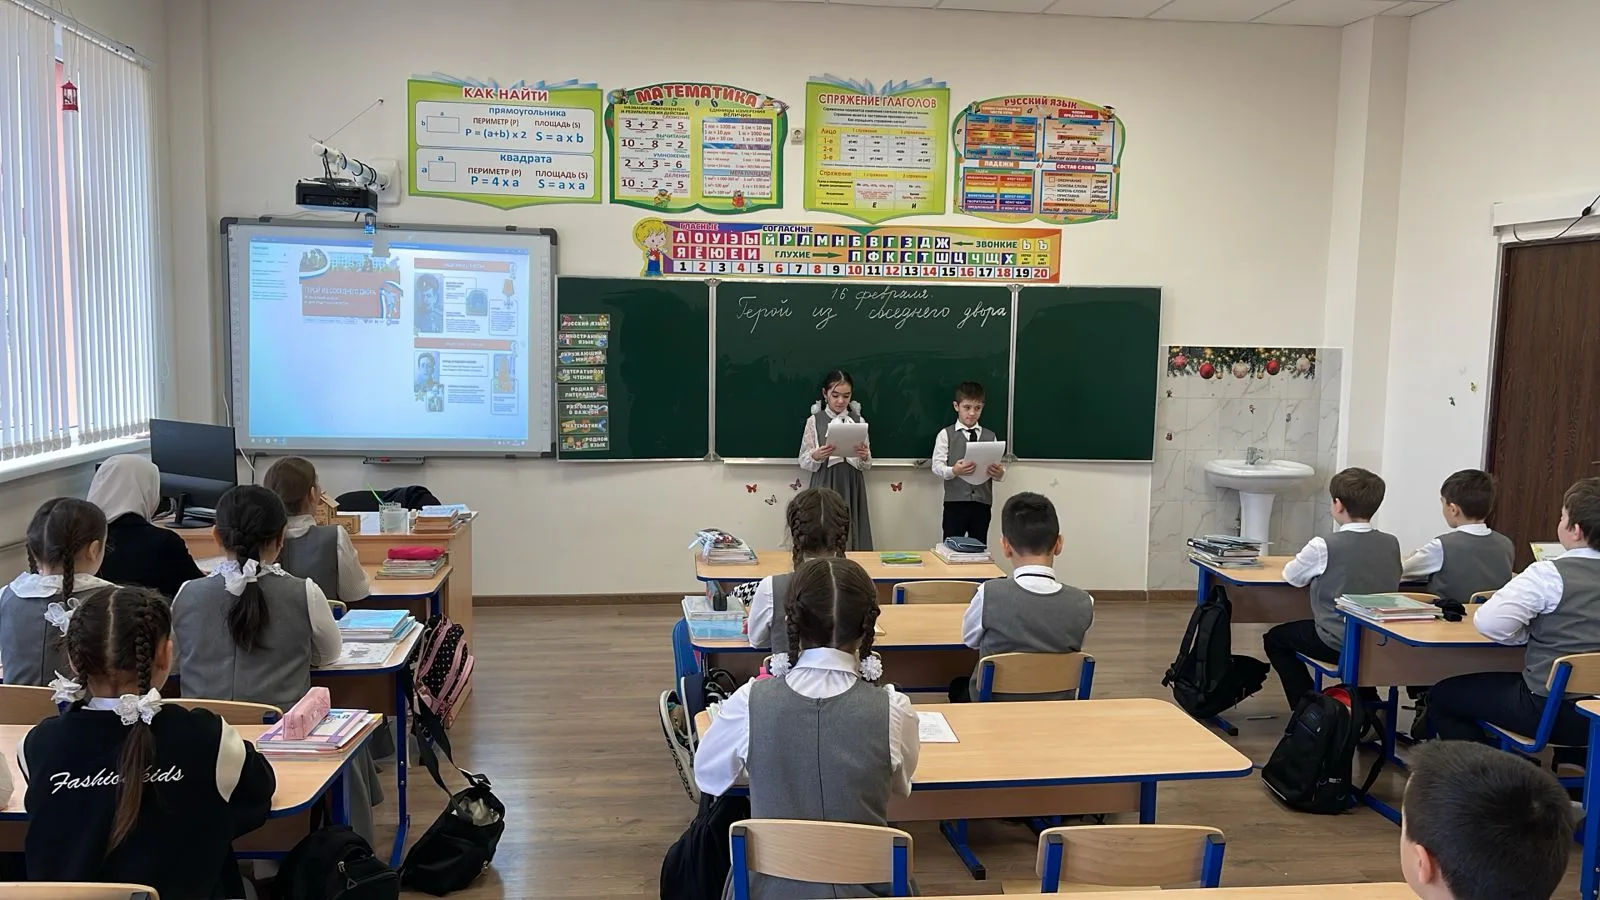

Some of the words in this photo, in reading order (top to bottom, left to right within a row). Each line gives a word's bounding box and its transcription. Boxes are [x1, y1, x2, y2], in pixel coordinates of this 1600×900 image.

[464, 88, 494, 99] КАК
[499, 88, 548, 102] НАЙТИ
[636, 85, 757, 108] МАТЕМАТИКА
[819, 94, 880, 106] СПРЯЖЕНИЕ
[882, 96, 937, 108] ГЛАГОЛОВ
[1004, 96, 1048, 106] РУССКИЙ
[1050, 99, 1077, 109] ЯЗЫК
[489, 107, 566, 117] прямоугольника
[473, 117, 508, 125] ПЕРИМЕТР
[535, 120, 570, 128] ПЛОЩАДЬ
[625, 120, 632, 128] 3
[652, 121, 658, 129] 2
[678, 122, 684, 130] 5
[483, 129, 510, 139] (a+b)
[521, 131, 527, 139] 2
[536, 131, 543, 141] S
[576, 133, 584, 143] b
[622, 139, 635, 147] 10
[652, 140, 659, 148] 8
[677, 141, 684, 149] 2
[500, 153, 552, 164] квадрата
[625, 159, 631, 167] 2
[652, 160, 659, 168] 3
[467, 167, 510, 175] ПЕРИМЕТР
[535, 170, 577, 179] ПЛОЩАДЬ
[492, 176, 499, 186] 4
[512, 179, 519, 187] a
[538, 179, 545, 189] S
[558, 181, 565, 189] a
[578, 182, 585, 190] a
[622, 179, 635, 187] 10
[652, 180, 659, 188] 2
[680, 222, 719, 230] ГЛАСНЫЕ
[762, 225, 813, 233] СОГЛАСНЫЕ
[676, 232, 686, 242] А
[694, 233, 704, 243] О
[712, 233, 721, 244] У
[730, 233, 738, 244] Э
[745, 234, 759, 245] Ы
[783, 235, 792, 245] Р
[800, 235, 810, 245] Л
[817, 235, 827, 245] М
[835, 236, 844, 246] Н
[852, 237, 861, 247] Б
[870, 237, 878, 247] В
[887, 237, 894, 247] Г
[904, 237, 912, 248] З
[920, 238, 930, 249] Д
[935, 238, 949, 248] Ж
[975, 240, 1018, 249] ЗВОНКИЕ
[677, 247, 685, 257] Я
[695, 247, 703, 259] Ё
[710, 248, 724, 258] Ю
[730, 249, 739, 259] Е
[747, 249, 757, 259] И
[775, 250, 811, 258] ГЛУХИЕ
[852, 251, 861, 261] П
[868, 251, 879, 262] Ф
[886, 252, 895, 262] К
[904, 252, 912, 262] С
[921, 253, 929, 262] Т
[935, 253, 949, 263] Ш
[954, 253, 964, 264] Ц
[971, 253, 980, 263] Ч
[986, 253, 999, 265] Щ
[1005, 254, 1013, 264] Х
[680, 262, 686, 271] 1
[699, 262, 706, 271] 2
[718, 263, 726, 272] 3
[737, 263, 745, 272] 4
[757, 263, 764, 273] 5
[776, 264, 783, 273] 6
[796, 264, 802, 273] 7
[814, 265, 821, 274] 8
[833, 265, 840, 274] 9
[848, 265, 862, 275] 10
[867, 266, 880, 275] 11
[886, 266, 899, 275] 12
[904, 266, 918, 276] 13
[923, 267, 937, 276] 14
[942, 267, 956, 276] 15
[960, 268, 974, 276] 16
[979, 268, 993, 277] 17
[997, 268, 1011, 277] 18
[1015, 268, 1030, 278] 19
[1034, 268, 1048, 278] 20
[831, 287, 848, 299] 16
[737, 296, 792, 334] Герой
[812, 307, 838, 330] из
[868, 306, 950, 329] соседнего
[957, 301, 1007, 329] двора
[50, 768, 125, 795] Fashio
